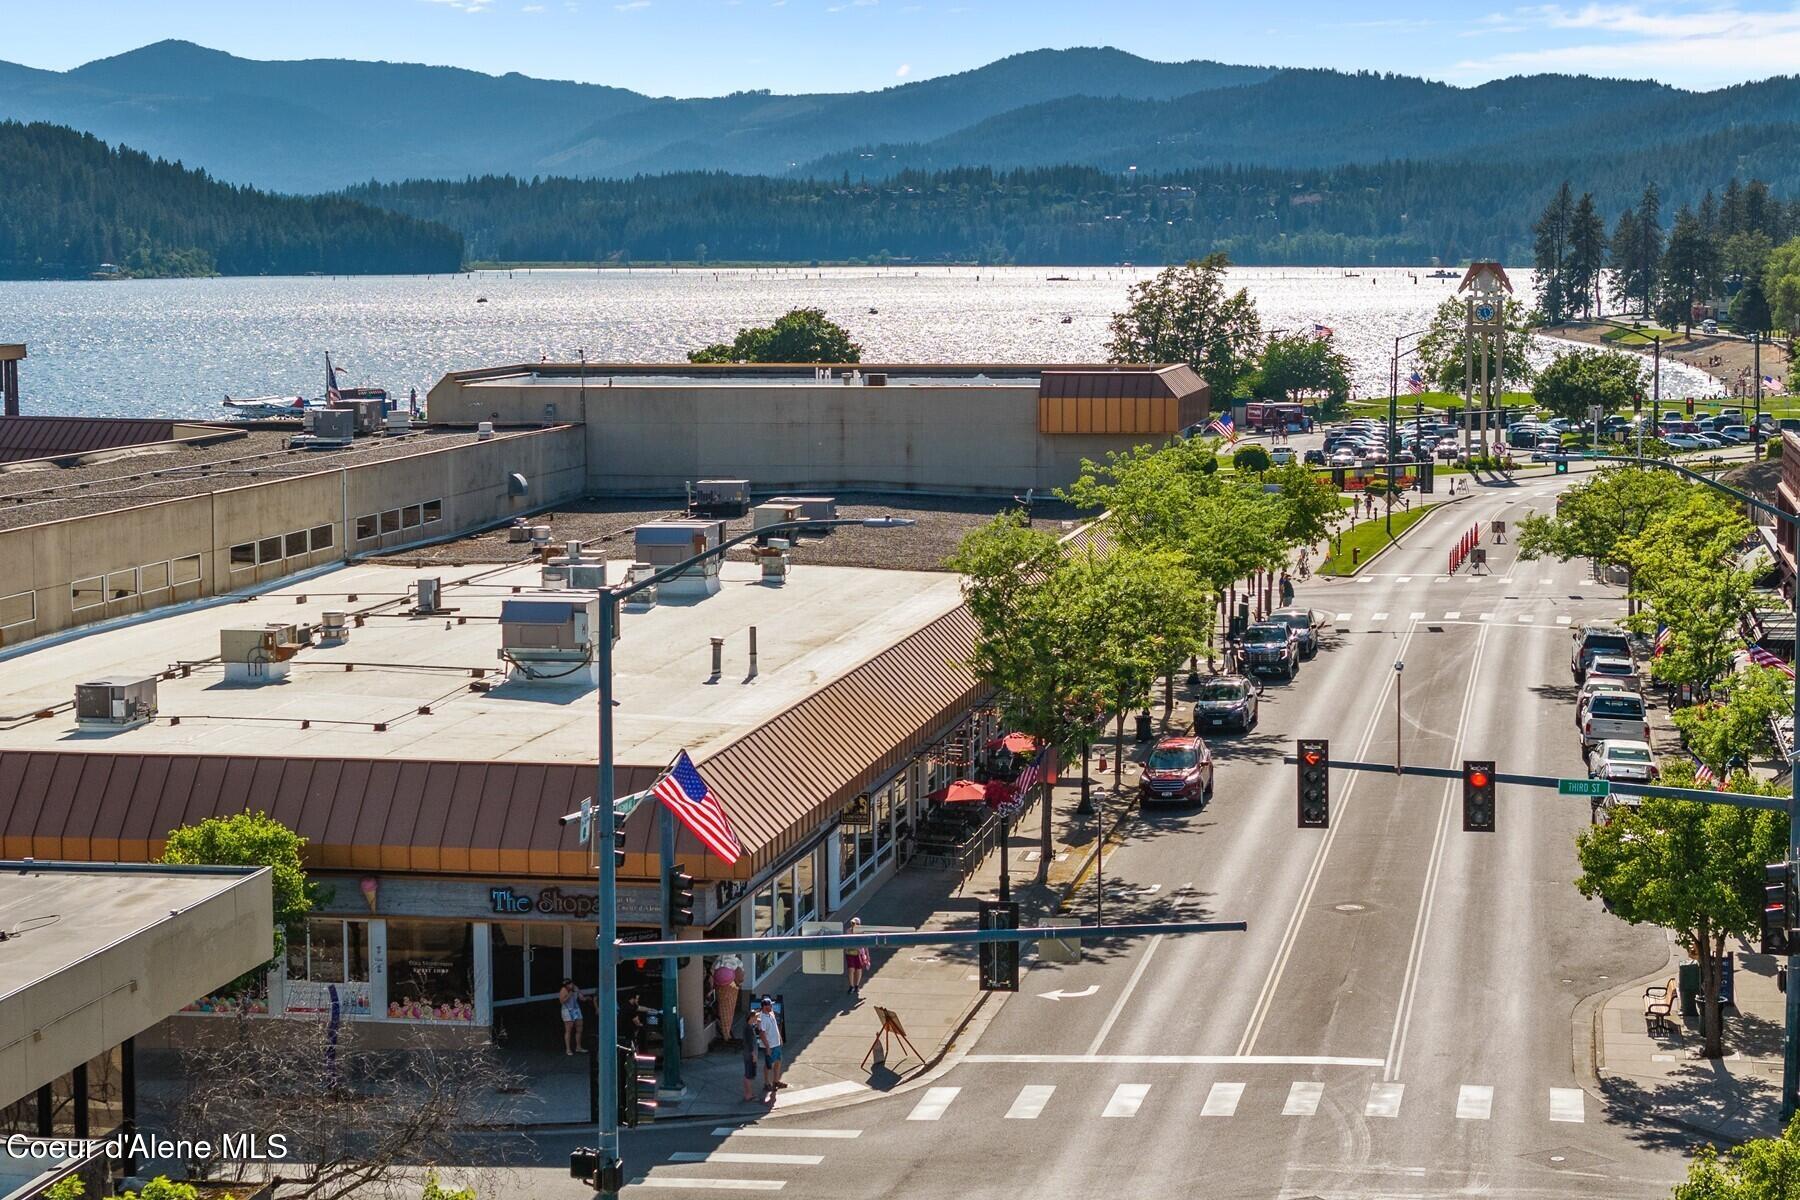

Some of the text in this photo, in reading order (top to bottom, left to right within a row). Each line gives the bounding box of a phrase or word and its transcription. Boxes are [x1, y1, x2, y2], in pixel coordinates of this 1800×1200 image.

[1568, 782, 1601, 793] THIRD ST
[491, 888, 530, 912] The
